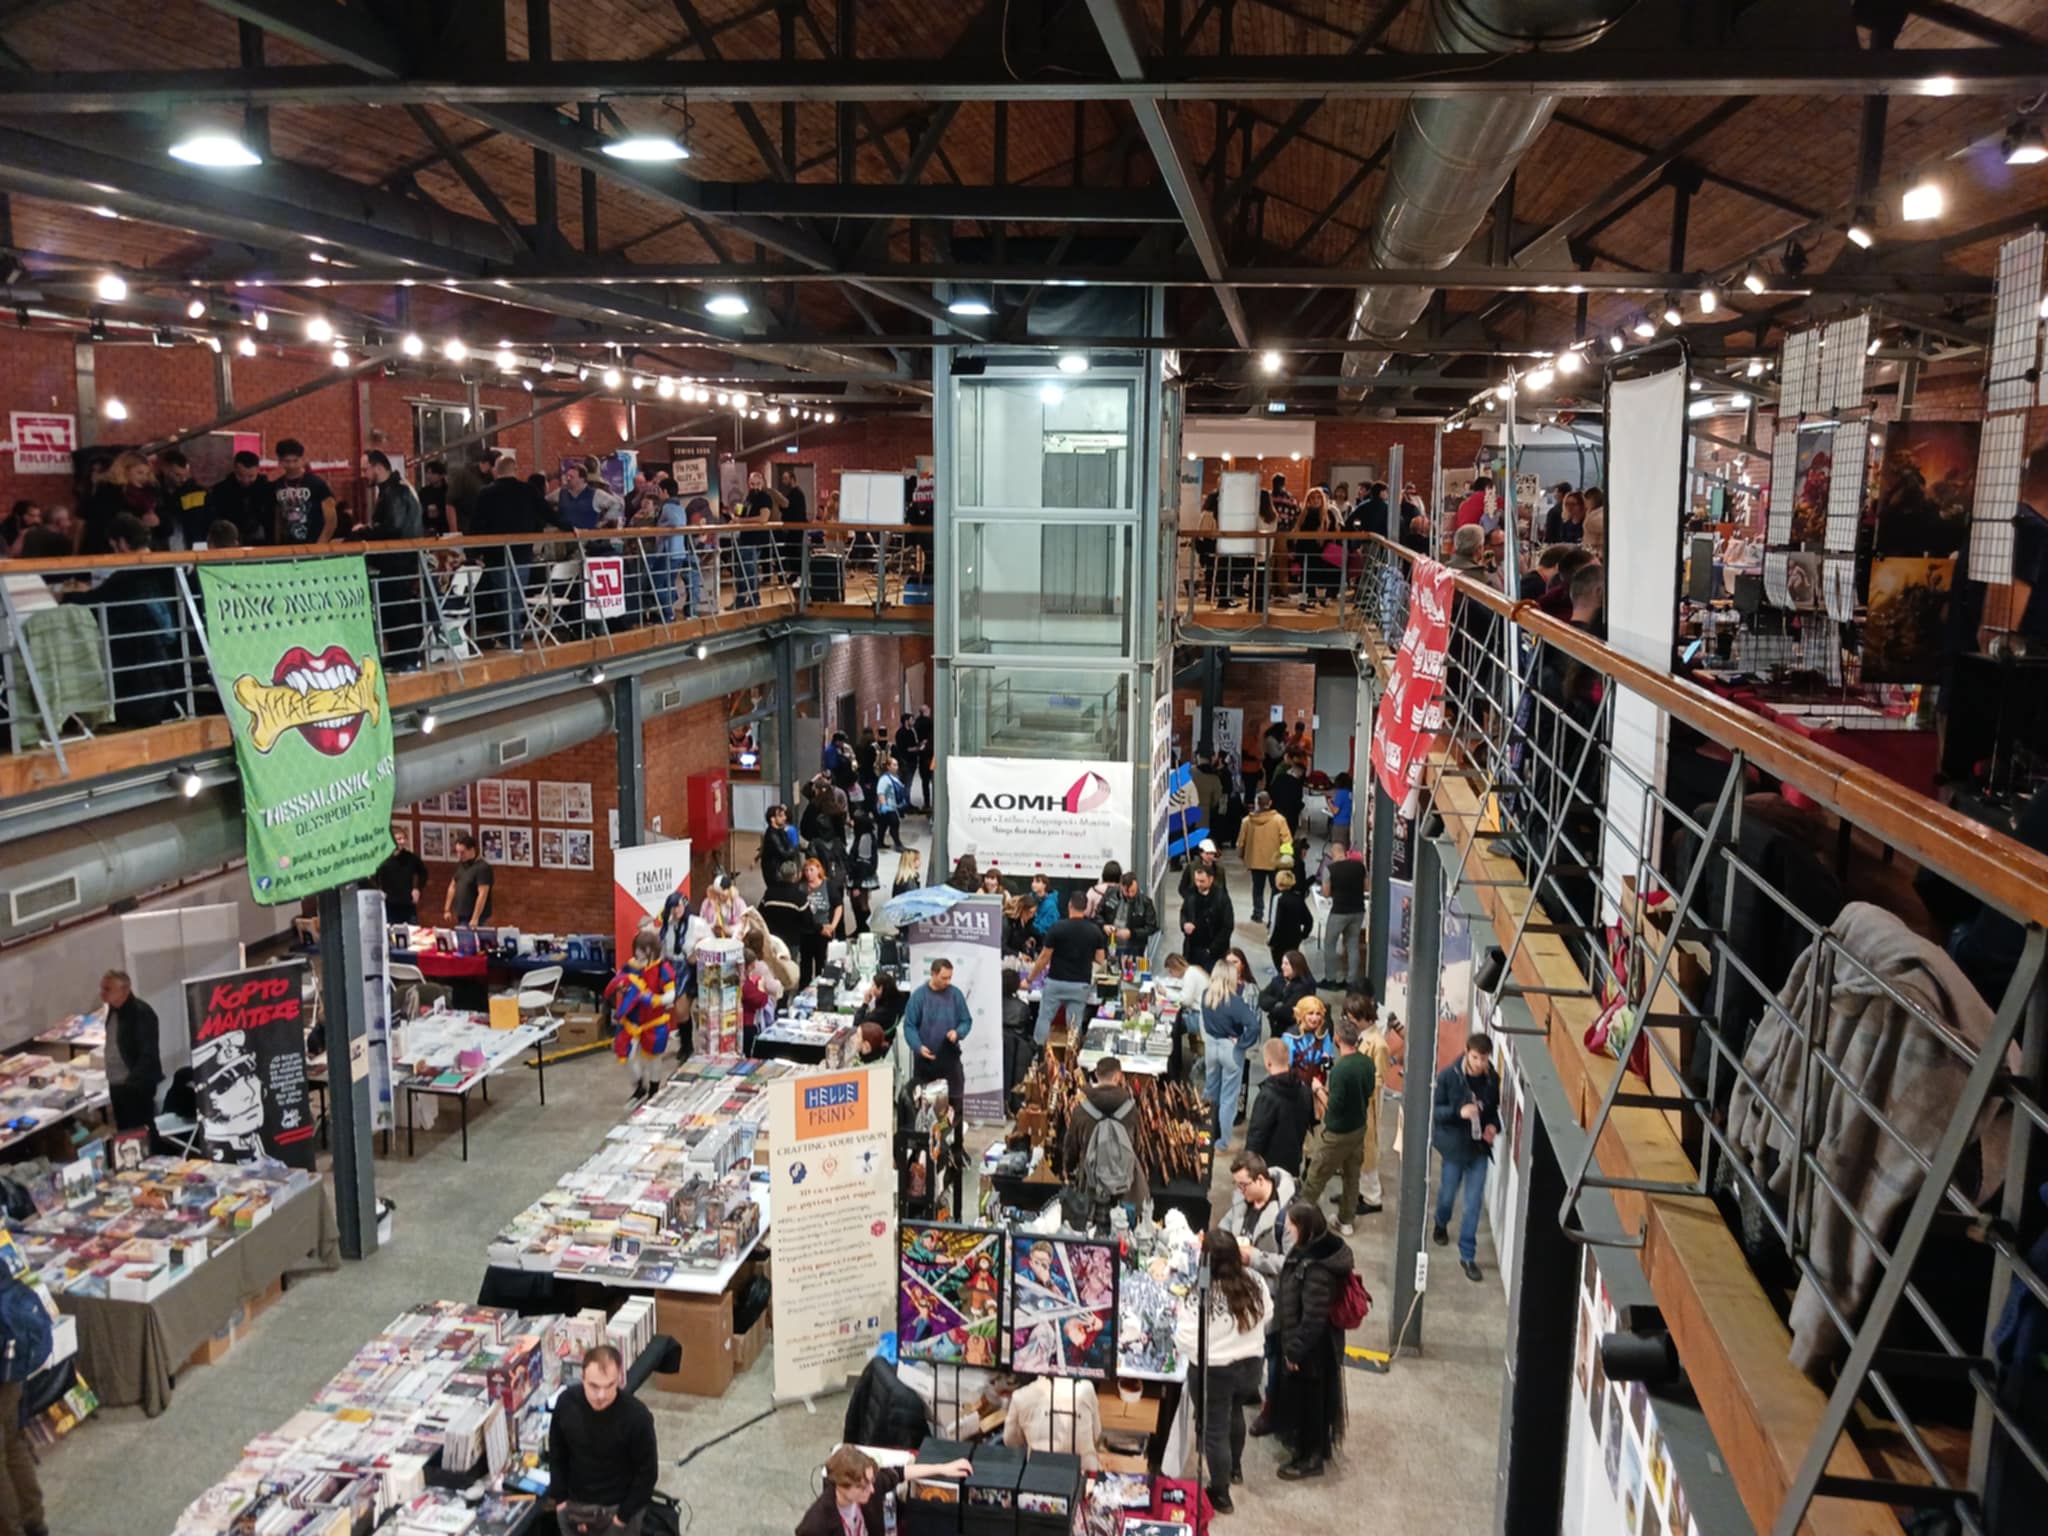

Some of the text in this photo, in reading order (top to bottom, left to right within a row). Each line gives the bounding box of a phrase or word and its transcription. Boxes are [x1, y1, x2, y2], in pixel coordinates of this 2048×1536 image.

[808, 1104, 855, 1127] PRINTS
[777, 1131, 888, 1156] CRAFTING YOUR VISION
